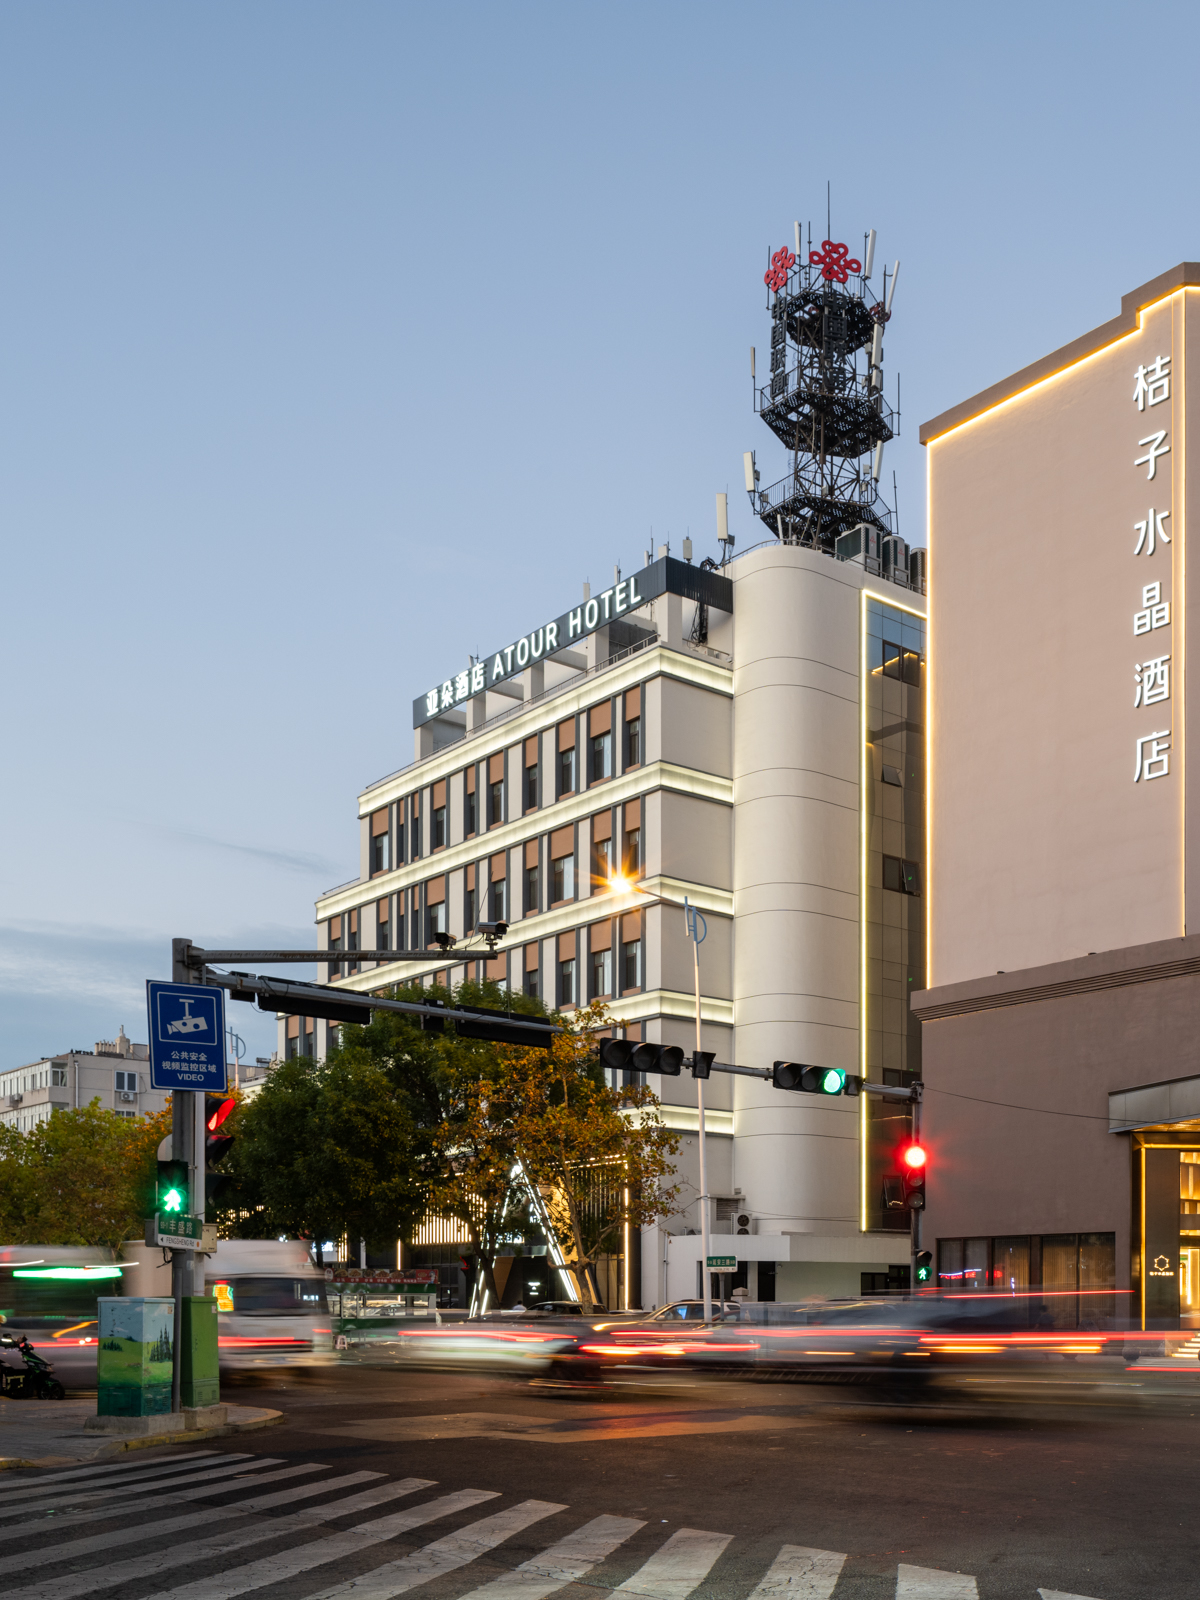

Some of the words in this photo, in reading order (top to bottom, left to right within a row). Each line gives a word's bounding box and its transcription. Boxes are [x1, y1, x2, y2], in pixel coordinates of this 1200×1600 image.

[770, 296, 788, 398] 中国联通
[1133, 355, 1171, 783] 桔子水晶酒店
[492, 622, 558, 681] ATOUR
[569, 576, 642, 638] HOTEL
[426, 662, 488, 717] 亚朵酒店
[162, 1061, 217, 1073] 视频监控区域
[171, 1051, 208, 1061] 公共安全
[177, 1073, 204, 1081] VIDEO
[169, 1219, 193, 1235] 丰盛路
